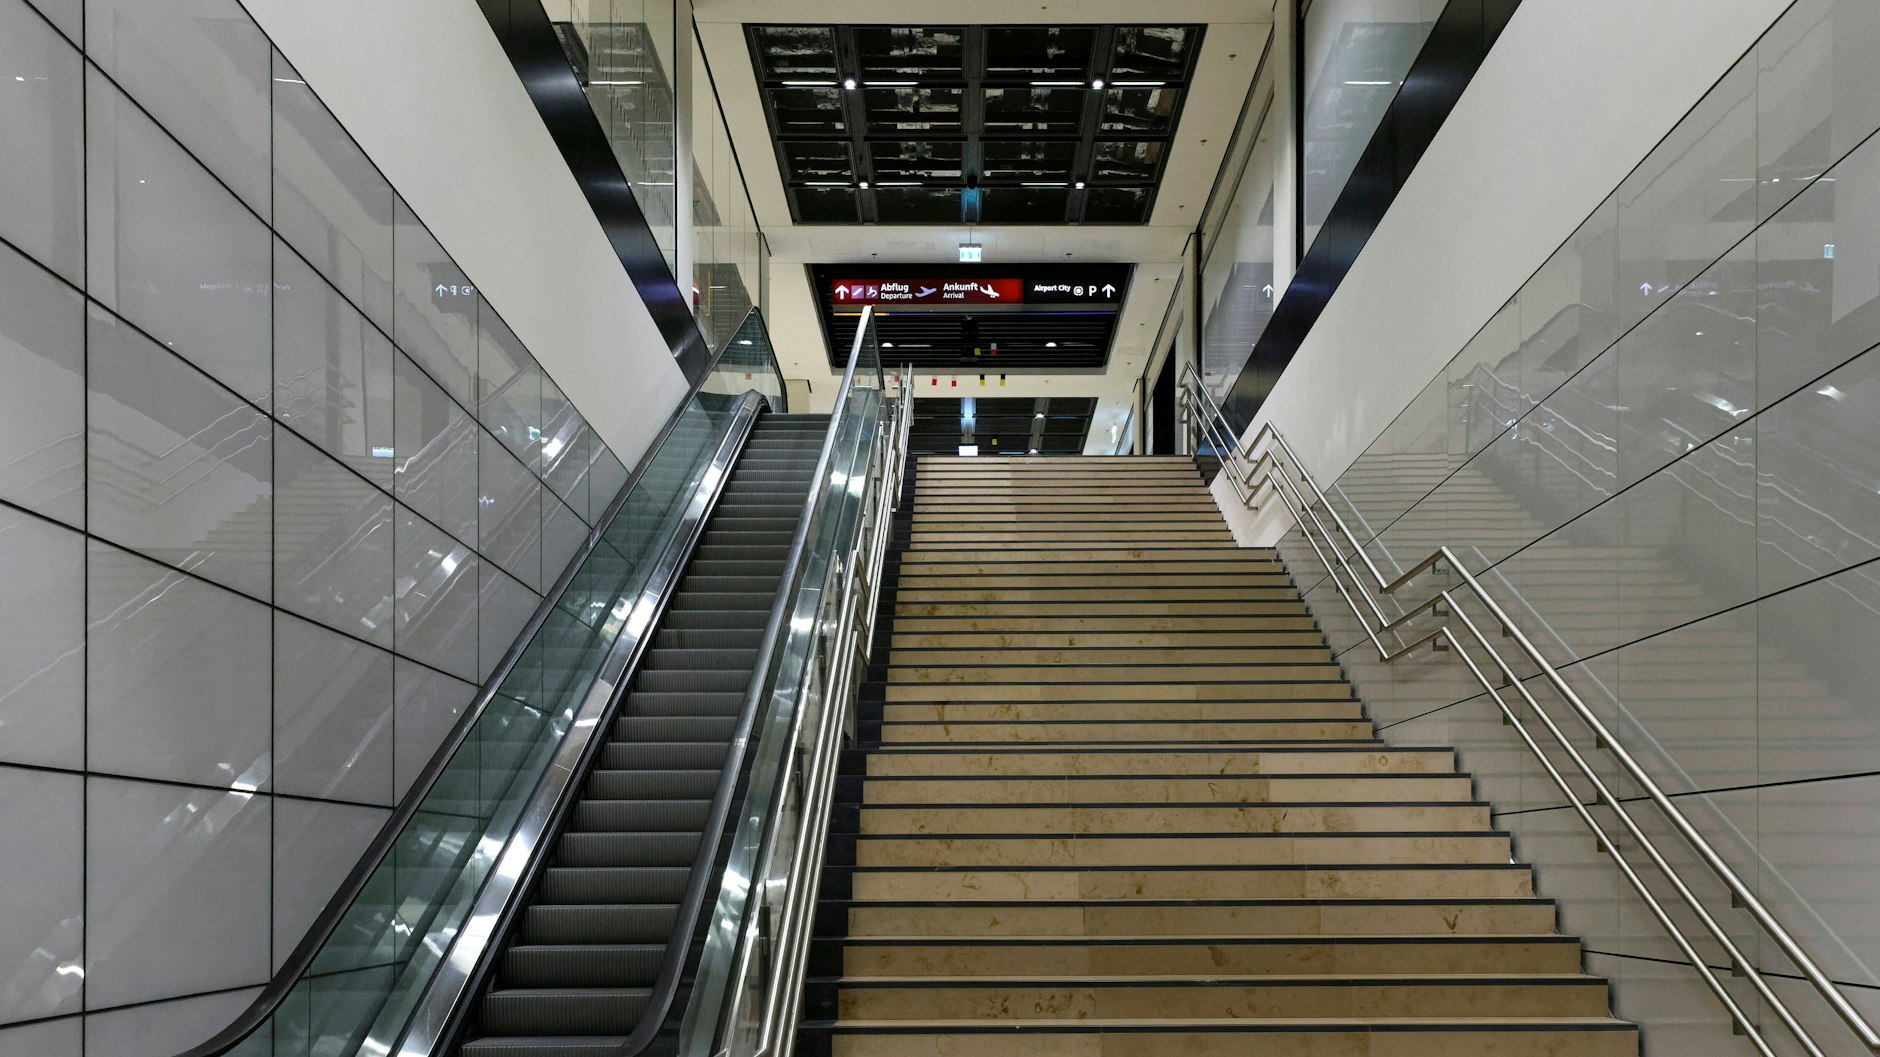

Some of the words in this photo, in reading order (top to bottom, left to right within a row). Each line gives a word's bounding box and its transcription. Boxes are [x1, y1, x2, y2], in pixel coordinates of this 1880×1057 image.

[880, 282, 909, 293] Abflug
[943, 281, 979, 291] Ankunft
[1034, 284, 1057, 292] Airport
[1058, 284, 1071, 292] City
[1088, 285, 1097, 296] P
[880, 292, 913, 300] Departure
